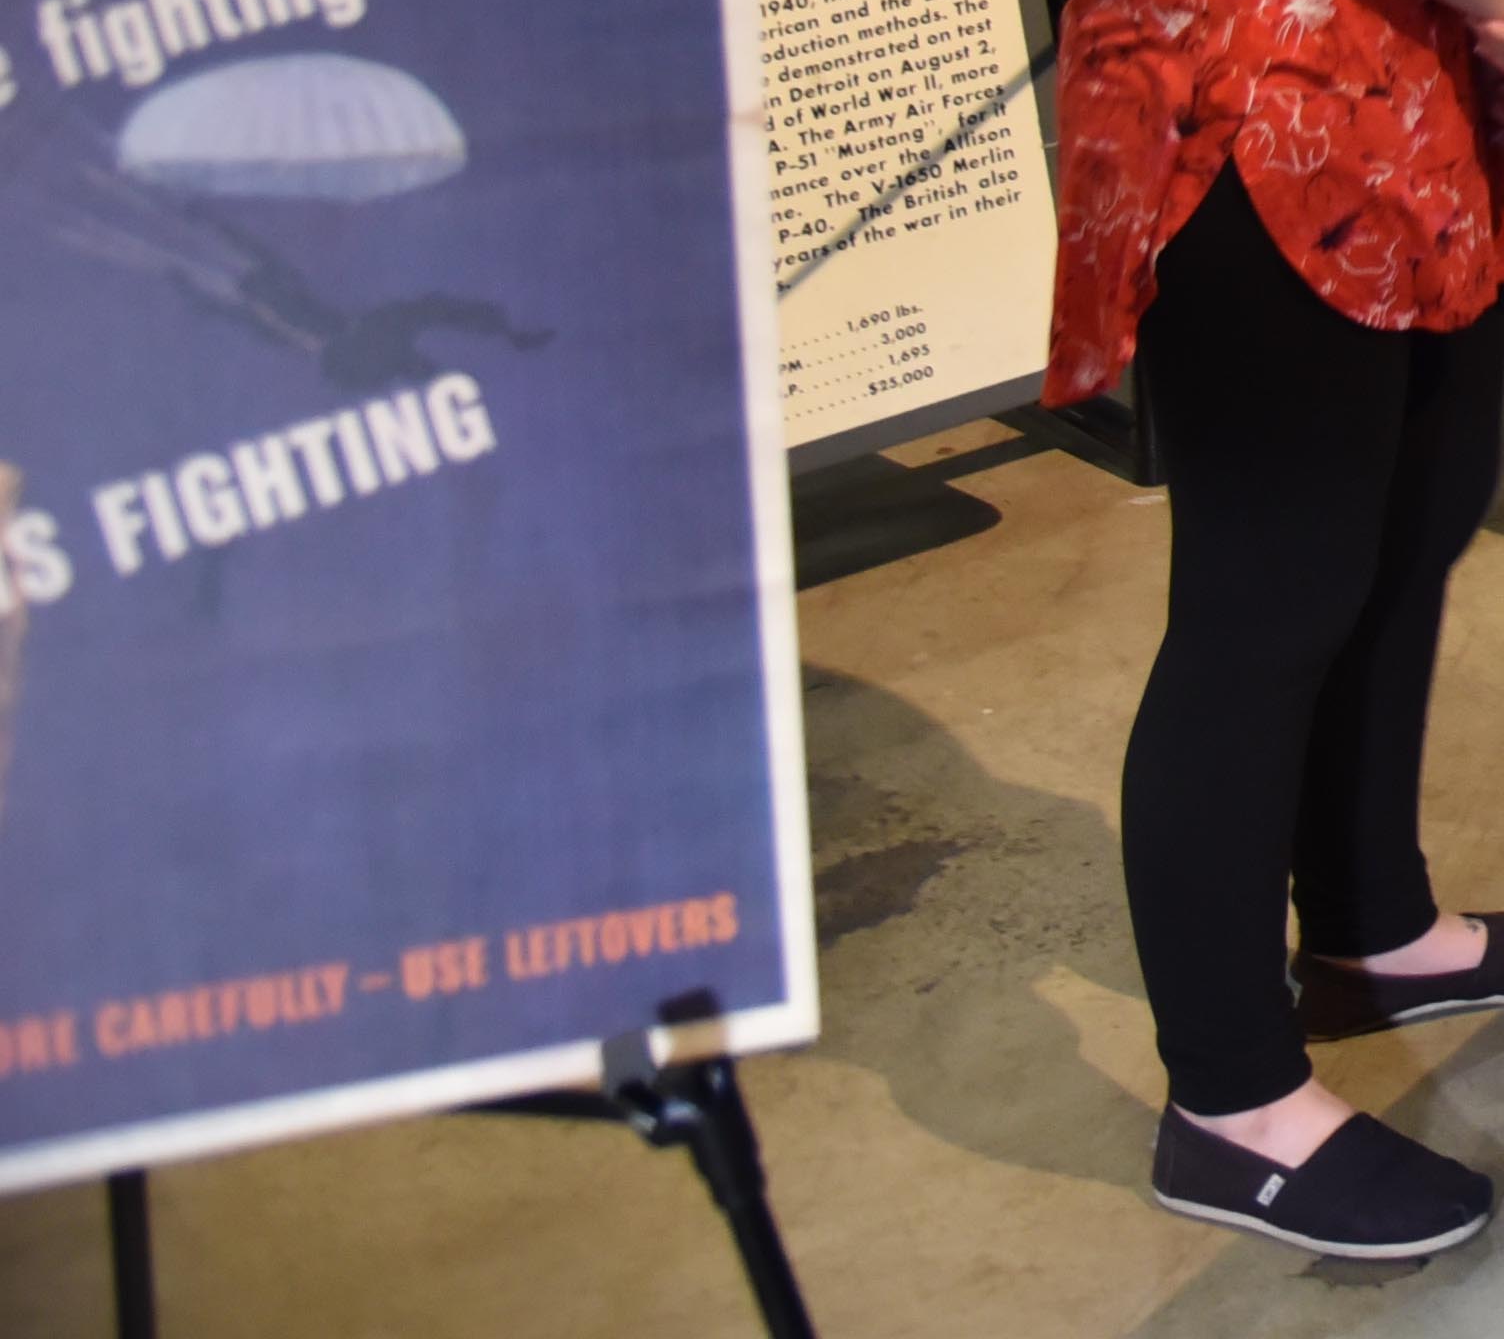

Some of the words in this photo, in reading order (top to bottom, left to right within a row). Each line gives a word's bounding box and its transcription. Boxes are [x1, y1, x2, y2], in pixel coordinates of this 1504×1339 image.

[831, 1, 870, 26] and
[857, 6, 949, 41] methods.
[778, 33, 921, 85] demonstrated
[926, 29, 952, 47] on
[957, 18, 993, 39] test
[789, 75, 861, 104] Detroit
[867, 66, 893, 85] on
[900, 43, 971, 77] August
[783, 106, 803, 129] of
[810, 91, 872, 119] World
[877, 82, 918, 103] War
[949, 63, 1000, 86] more
[797, 125, 835, 147] The
[843, 111, 897, 137] Army
[905, 101, 936, 120] Air
[942, 84, 1006, 110] Forces
[775, 152, 818, 176] P-51
[957, 109, 988, 130] for
[993, 101, 1008, 119] it
[841, 159, 888, 183] over
[899, 146, 932, 167] the
[943, 125, 1013, 154] Allison
[778, 218, 836, 246] P-40.
[858, 201, 894, 223] The
[904, 181, 969, 210] British
[978, 169, 1020, 190] also
[823, 188, 861, 210] The
[871, 163, 943, 196] V-1650
[952, 147, 1016, 175] Merlin
[772, 243, 831, 274] years
[835, 233, 859, 253] of
[864, 225, 897, 244] the
[904, 212, 943, 233] war
[948, 203, 969, 221] in
[974, 187, 1024, 214] their
[847, 309, 892, 333] 1,690
[895, 303, 924, 319] lbs.
[880, 321, 928, 346] 3,000
[868, 365, 935, 397] $25,000
[888, 343, 932, 367] 1,695
[92, 371, 498, 578] FIGHTING
[97, 964, 350, 1056] CAREFULLY
[400, 937, 490, 1000] USE
[505, 891, 740, 983] LEFTOVERS
